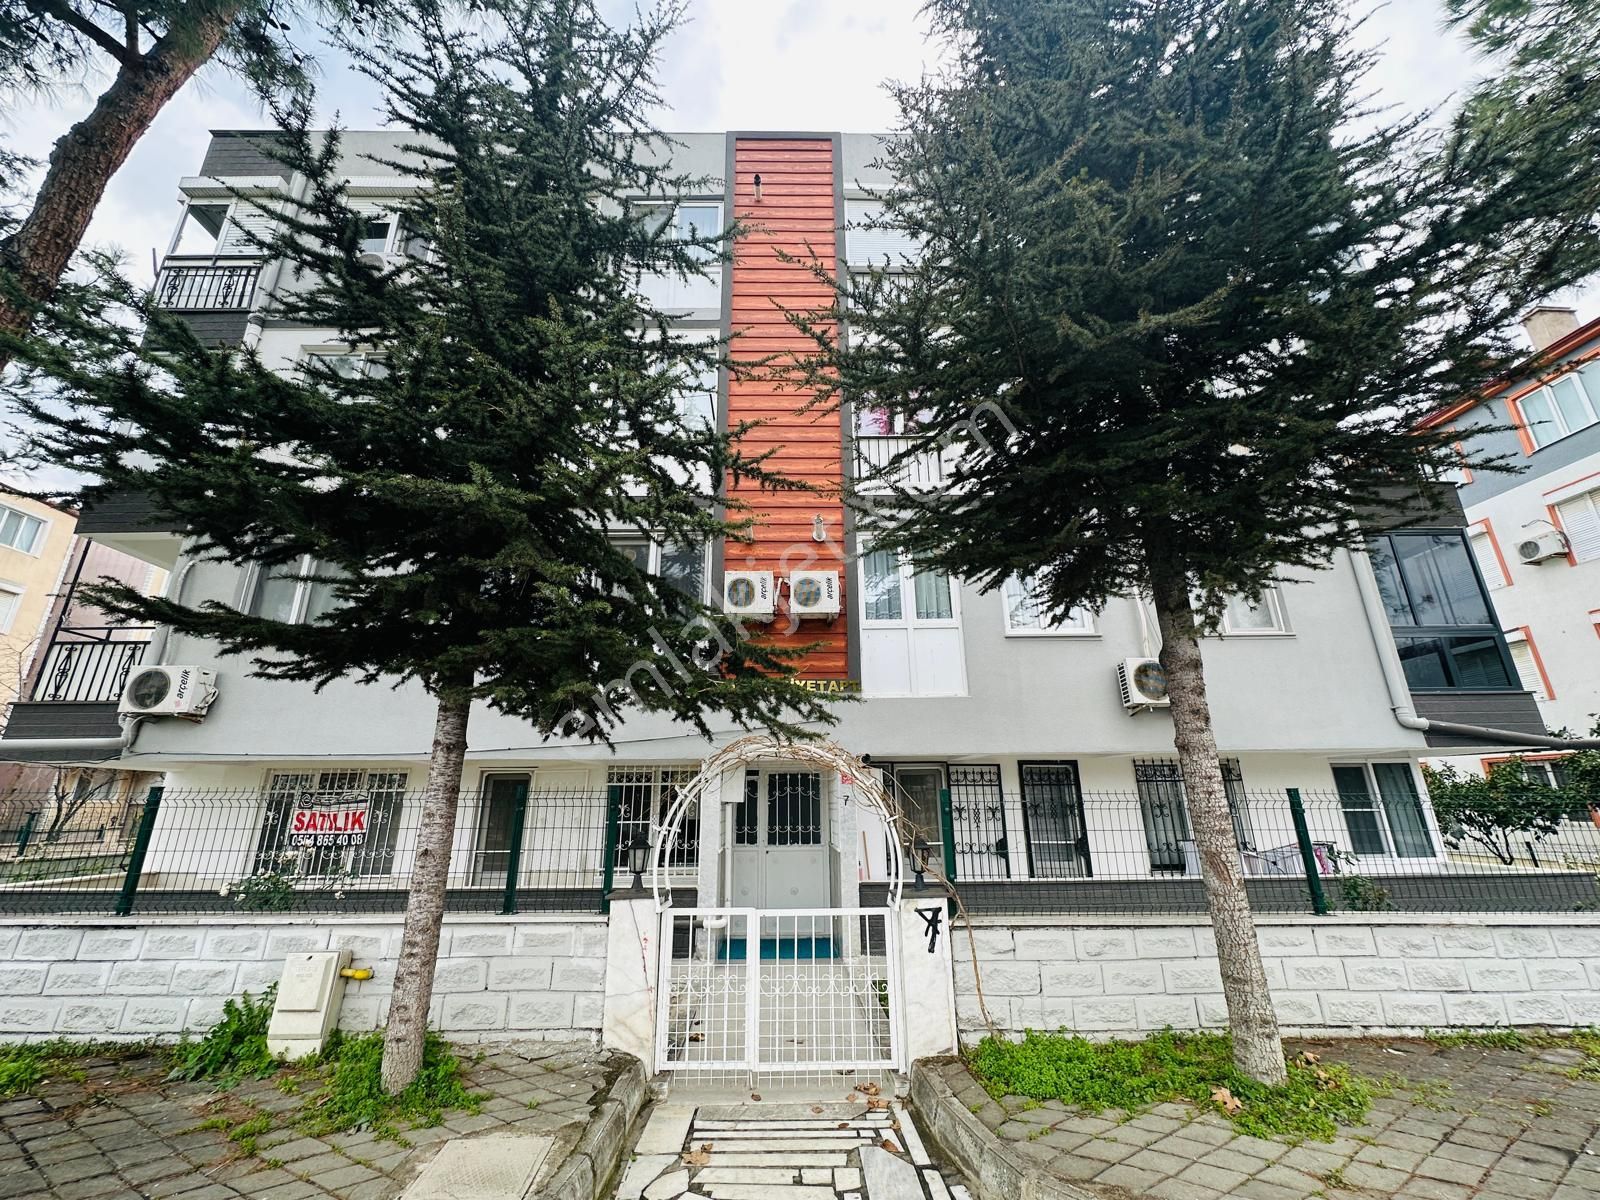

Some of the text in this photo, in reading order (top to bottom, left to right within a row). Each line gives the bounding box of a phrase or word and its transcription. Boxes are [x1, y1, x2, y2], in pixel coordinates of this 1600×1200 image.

[826, 577, 834, 600] arçelik
[177, 669, 191, 699] arçelik
[294, 811, 366, 832] SATILIK
[316, 834, 335, 846] 865
[336, 834, 348, 846] 40
[351, 834, 363, 846] 08
